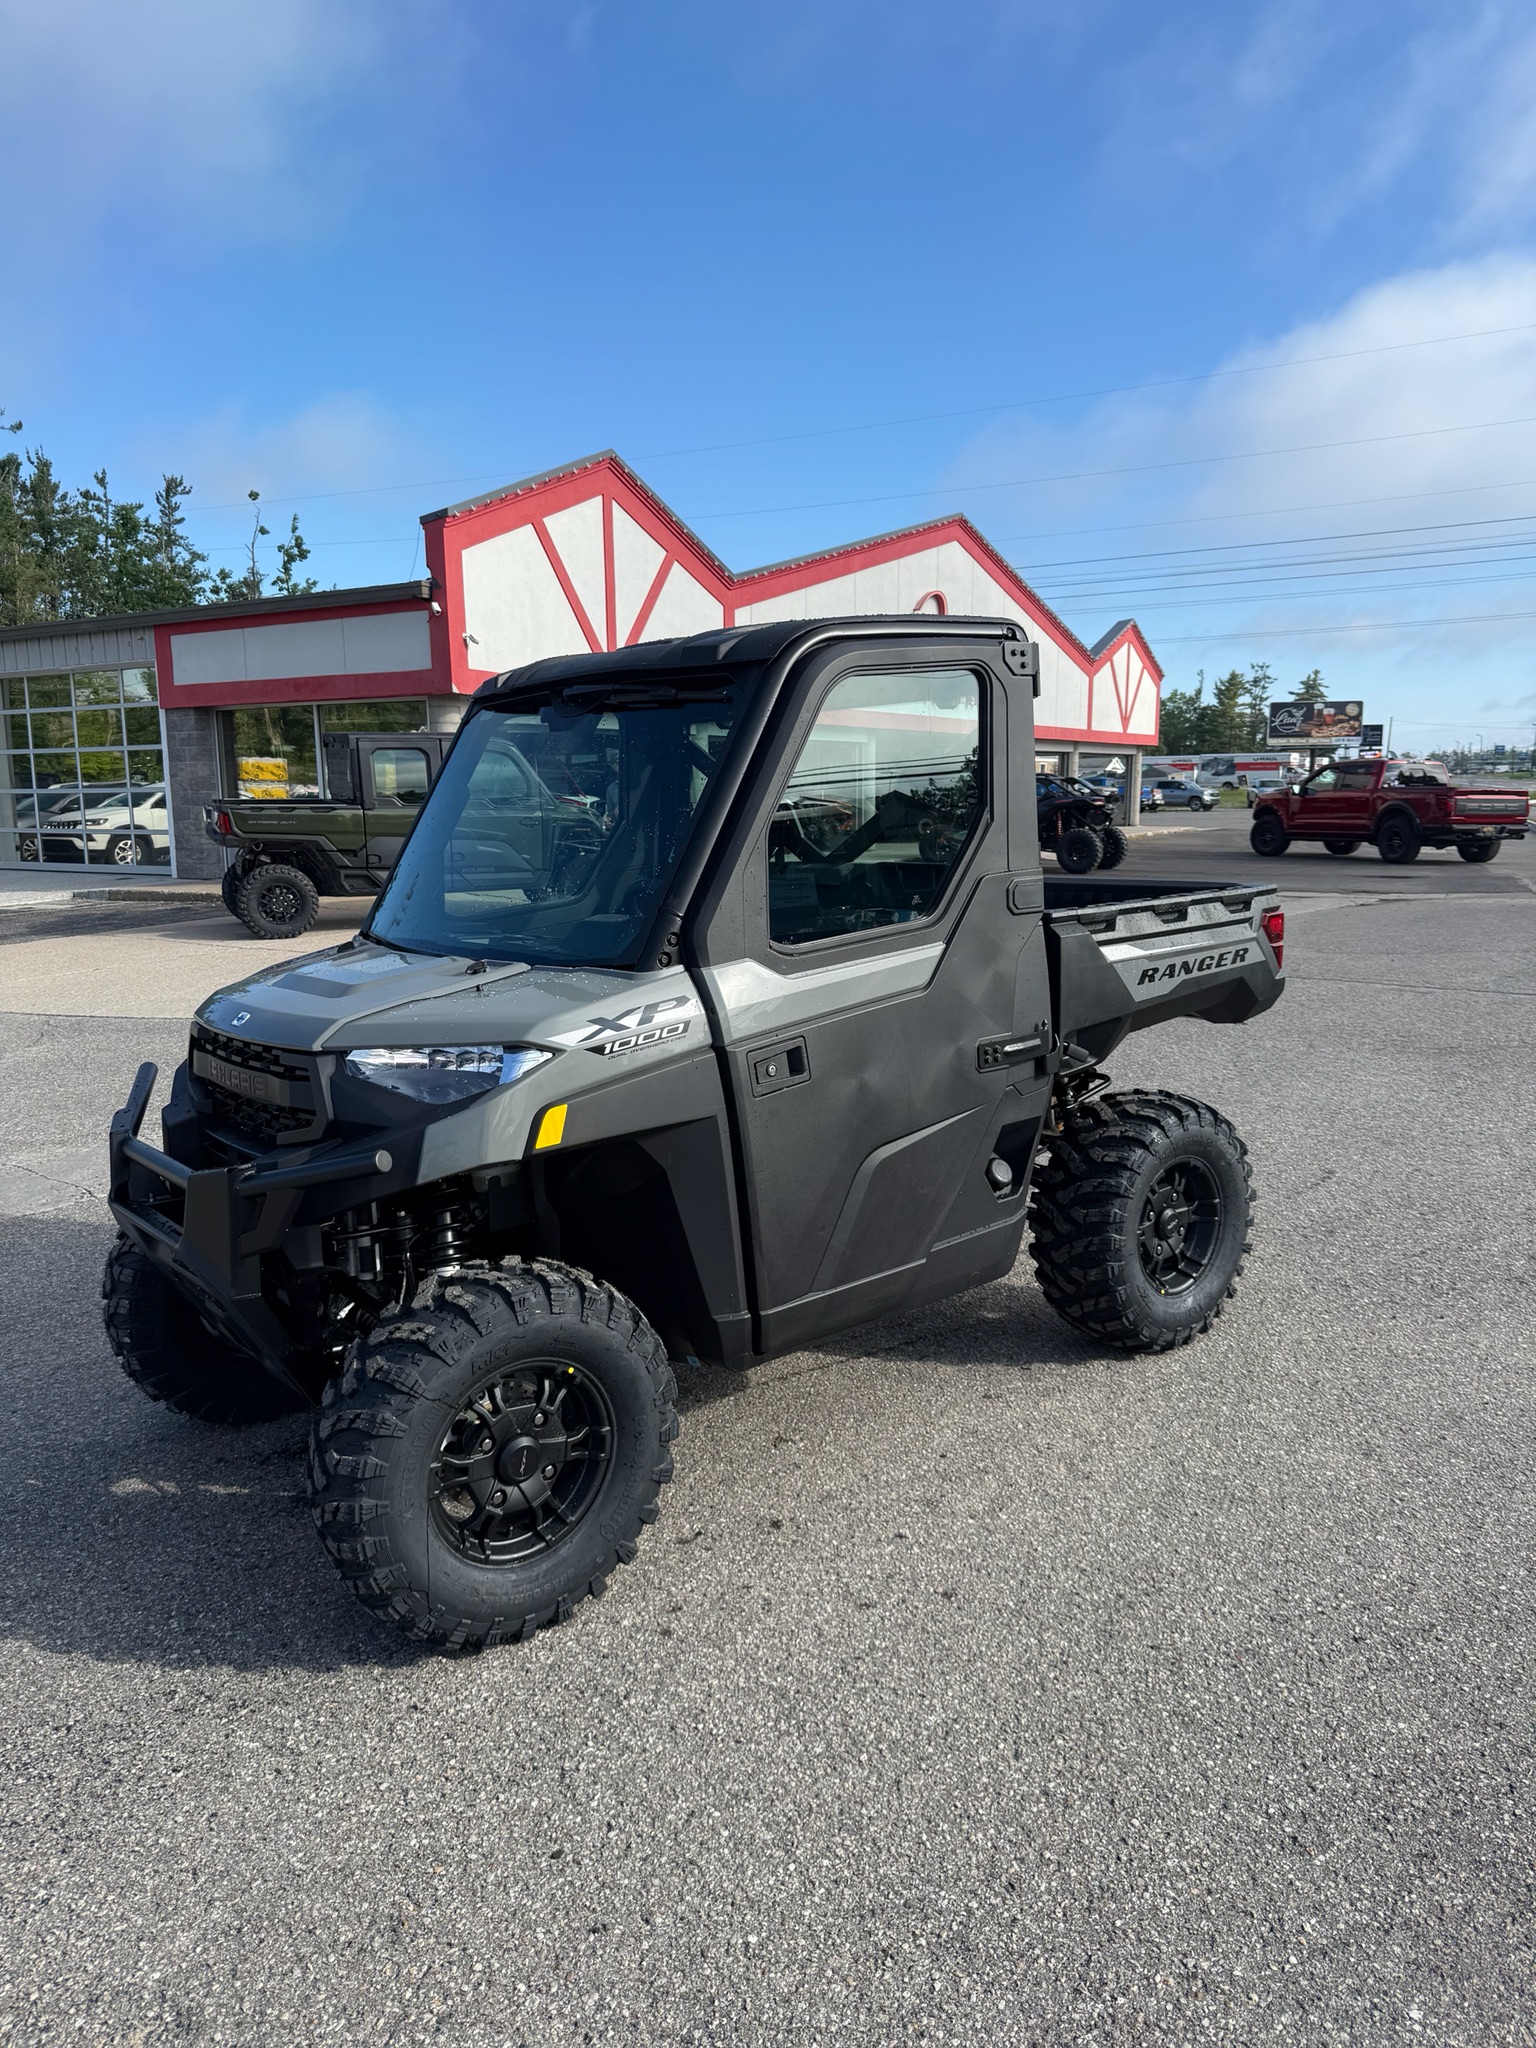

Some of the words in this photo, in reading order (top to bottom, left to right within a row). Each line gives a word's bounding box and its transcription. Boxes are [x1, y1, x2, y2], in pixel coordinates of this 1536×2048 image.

[1137, 947, 1249, 986] RANGER
[577, 995, 691, 1043] XP
[603, 1022, 685, 1055] 1000
[607, 1051, 628, 1060] DUAL
[629, 1040, 670, 1054] OVERHEAD
[210, 1060, 264, 1095] POLARIS
